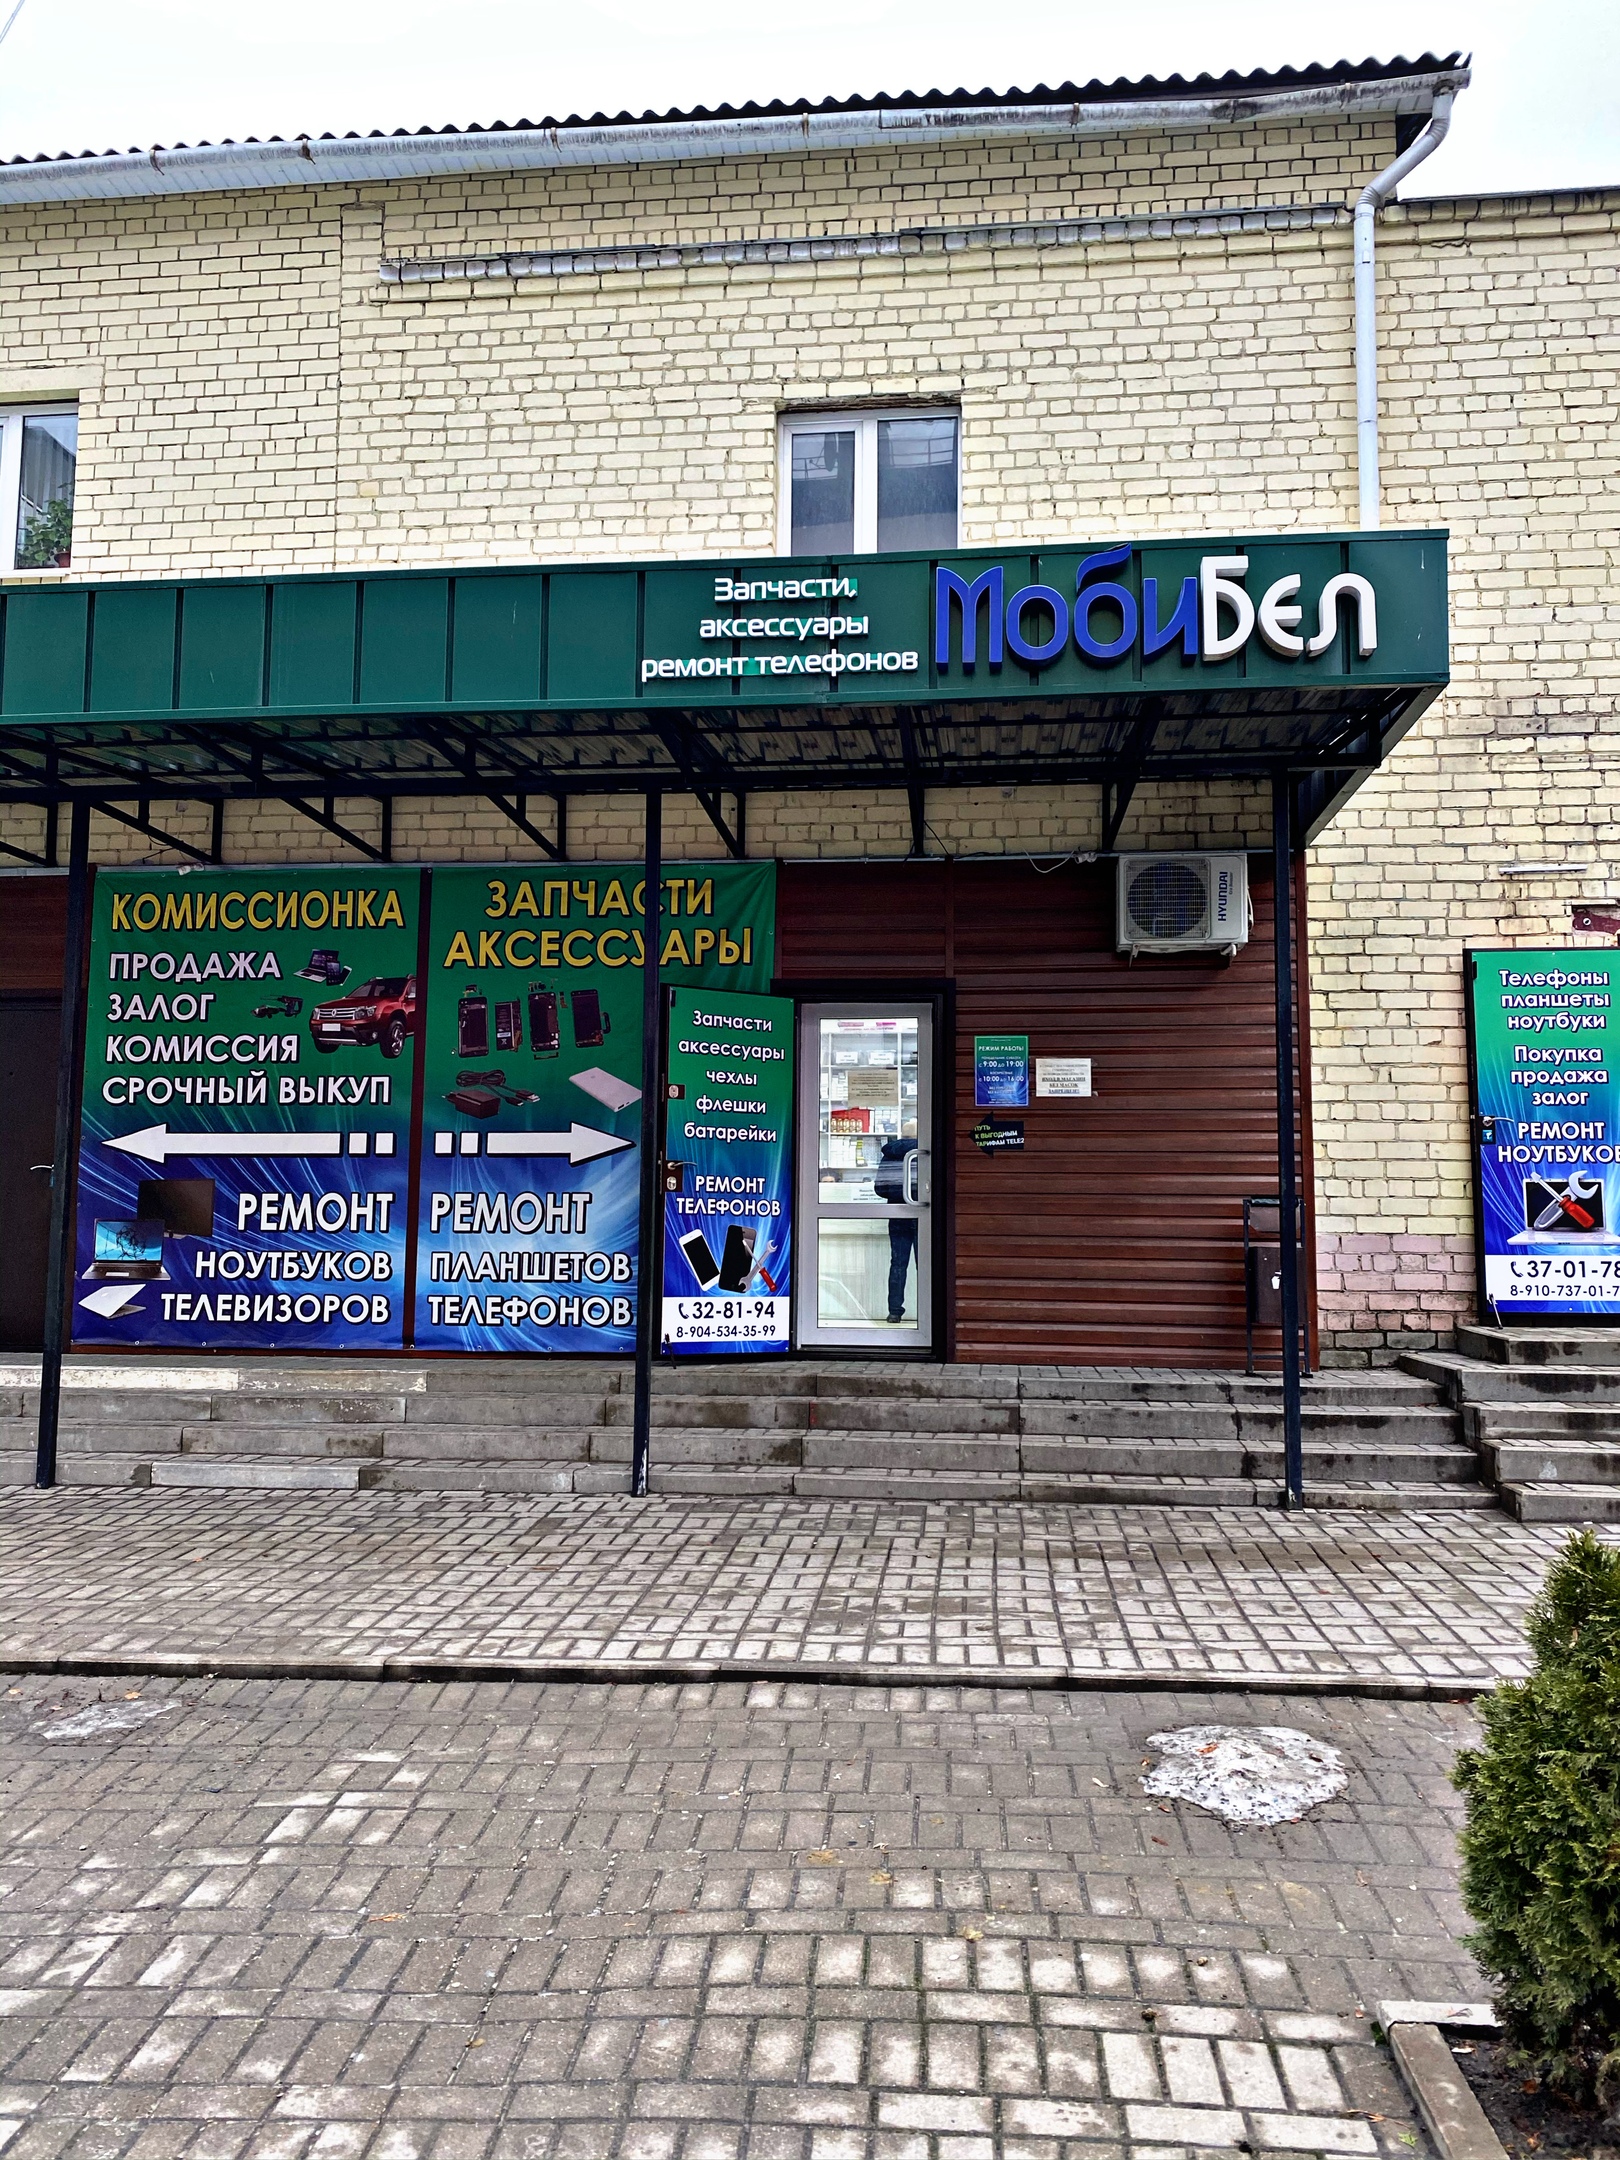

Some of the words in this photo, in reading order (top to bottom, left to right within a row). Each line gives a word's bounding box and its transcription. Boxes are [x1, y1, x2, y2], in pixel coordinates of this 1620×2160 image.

[714, 577, 857, 601] Запчасти,
[700, 616, 869, 641] аксессуары
[641, 657, 748, 682] ремонт
[755, 649, 918, 677] телефонов
[485, 879, 713, 917] ЗАПЧАСТИ
[1218, 872, 1228, 921] HYUNDAI
[112, 890, 404, 930] КОМИССИОНКА
[109, 952, 281, 982] ПРОДАЖА
[1499, 969, 1608, 989] Телефоны
[108, 994, 214, 1020] ЗАЛОГ
[1502, 994, 1610, 1007] планшеты
[692, 1010, 772, 1031] Запчасти
[1508, 1012, 1605, 1032] ноутбуки
[106, 1035, 298, 1063] КОМИССИЯ
[678, 1040, 784, 1062] аксессуары
[1514, 1046, 1602, 1065] Покупка
[102, 1070, 267, 1104] СРОЧНЫЙ
[279, 1076, 390, 1104] ВЫКУП
[706, 1070, 757, 1085] чехлы
[1511, 1070, 1608, 1086] продажа
[696, 1095, 766, 1113] флешки
[1532, 1092, 1588, 1105] залог
[684, 1123, 776, 1142] батарейки
[980, 1130, 1018, 1138] ВЫГОДНЫМ
[1518, 1122, 1605, 1140] РЕМОНТ
[695, 1176, 765, 1193] РЕМОНТ
[238, 1193, 393, 1232] РЕМОНТ
[430, 1192, 591, 1233] РЕМОНТ
[677, 1198, 780, 1216] ТЕЛЕФОНОВ
[195, 1251, 391, 1280] НОУТБУКОВ
[431, 1252, 631, 1281] ПЛАНШЕТОВ
[161, 1293, 389, 1323] ТЕЛЕВИЗОРОВ
[428, 1296, 631, 1325] ТЕЛЕФОНОВ
[692, 1301, 775, 1318] 32-81-94
[677, 1325, 776, 1337] 8-904-534-35-99
